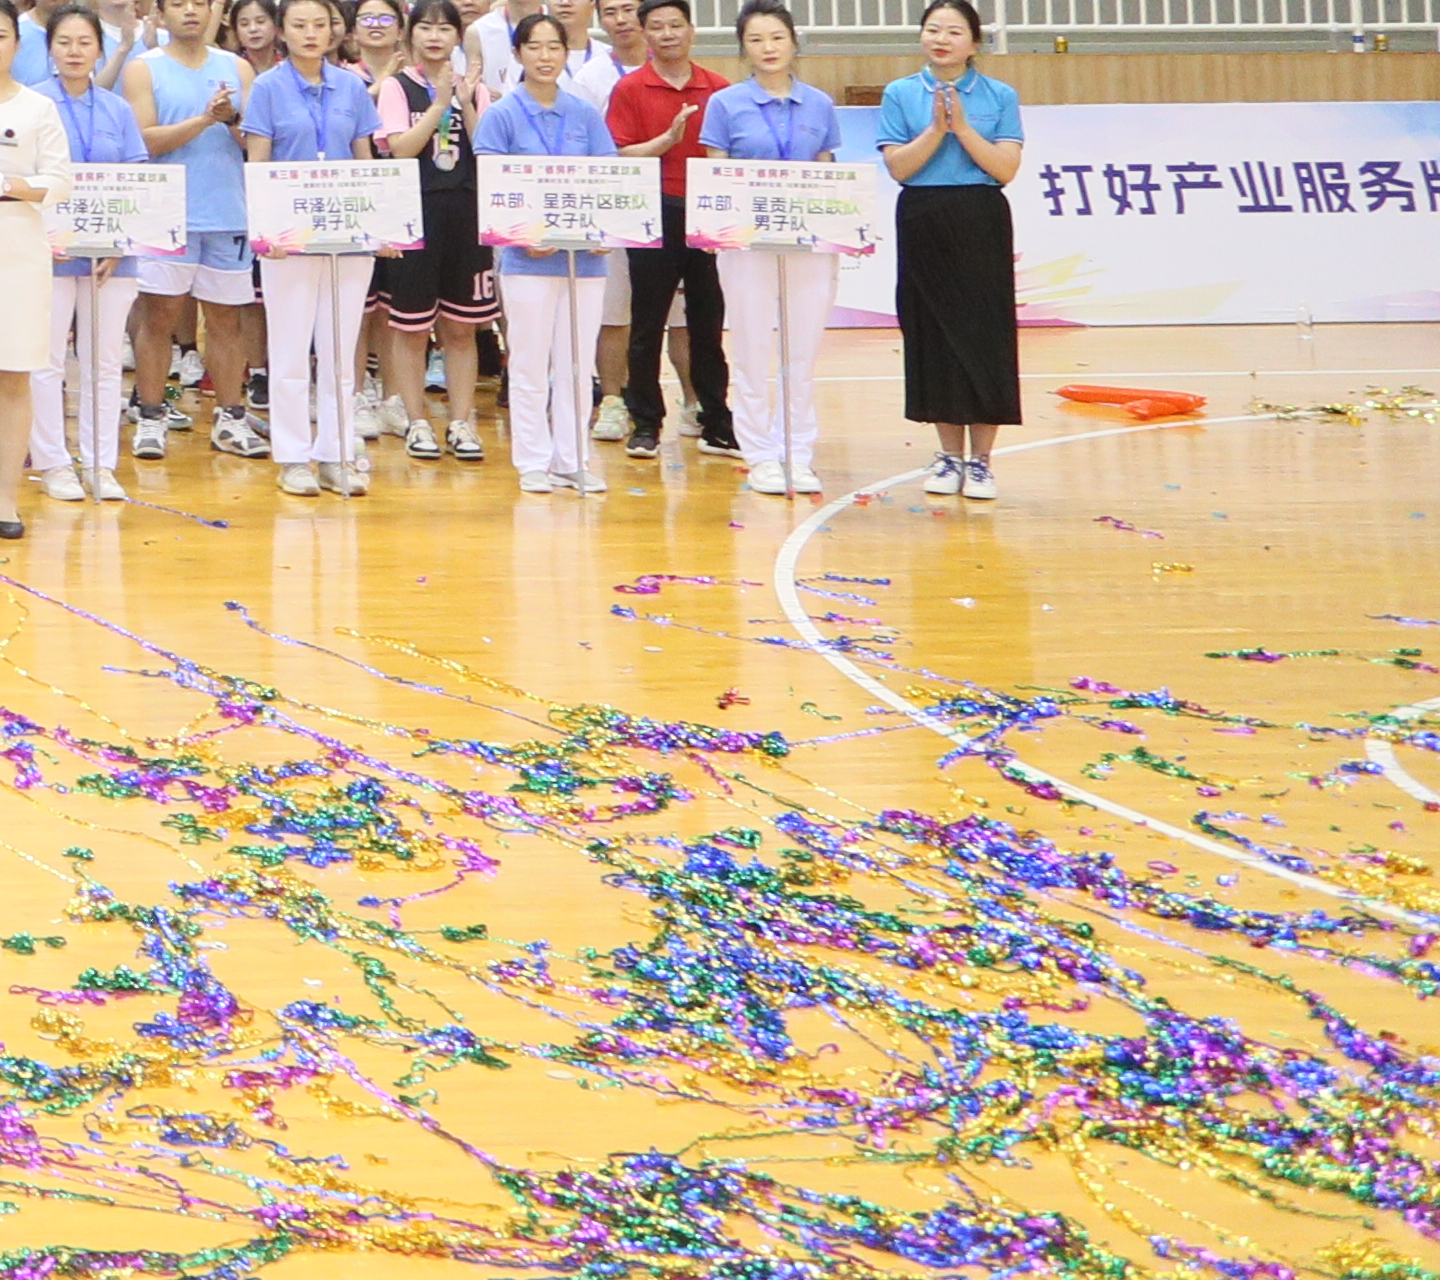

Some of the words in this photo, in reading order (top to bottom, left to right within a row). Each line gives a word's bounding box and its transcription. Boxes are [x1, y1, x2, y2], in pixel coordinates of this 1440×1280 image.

[55, 197, 141, 215] 民泽公司队
[292, 196, 377, 213] 民泽公司队
[489, 191, 650, 211] 本部、呈贡片区联队
[72, 216, 124, 234] 女子队
[310, 214, 361, 231] 男子队
[543, 212, 598, 230] 女子队
[754, 213, 808, 232] 男子队
